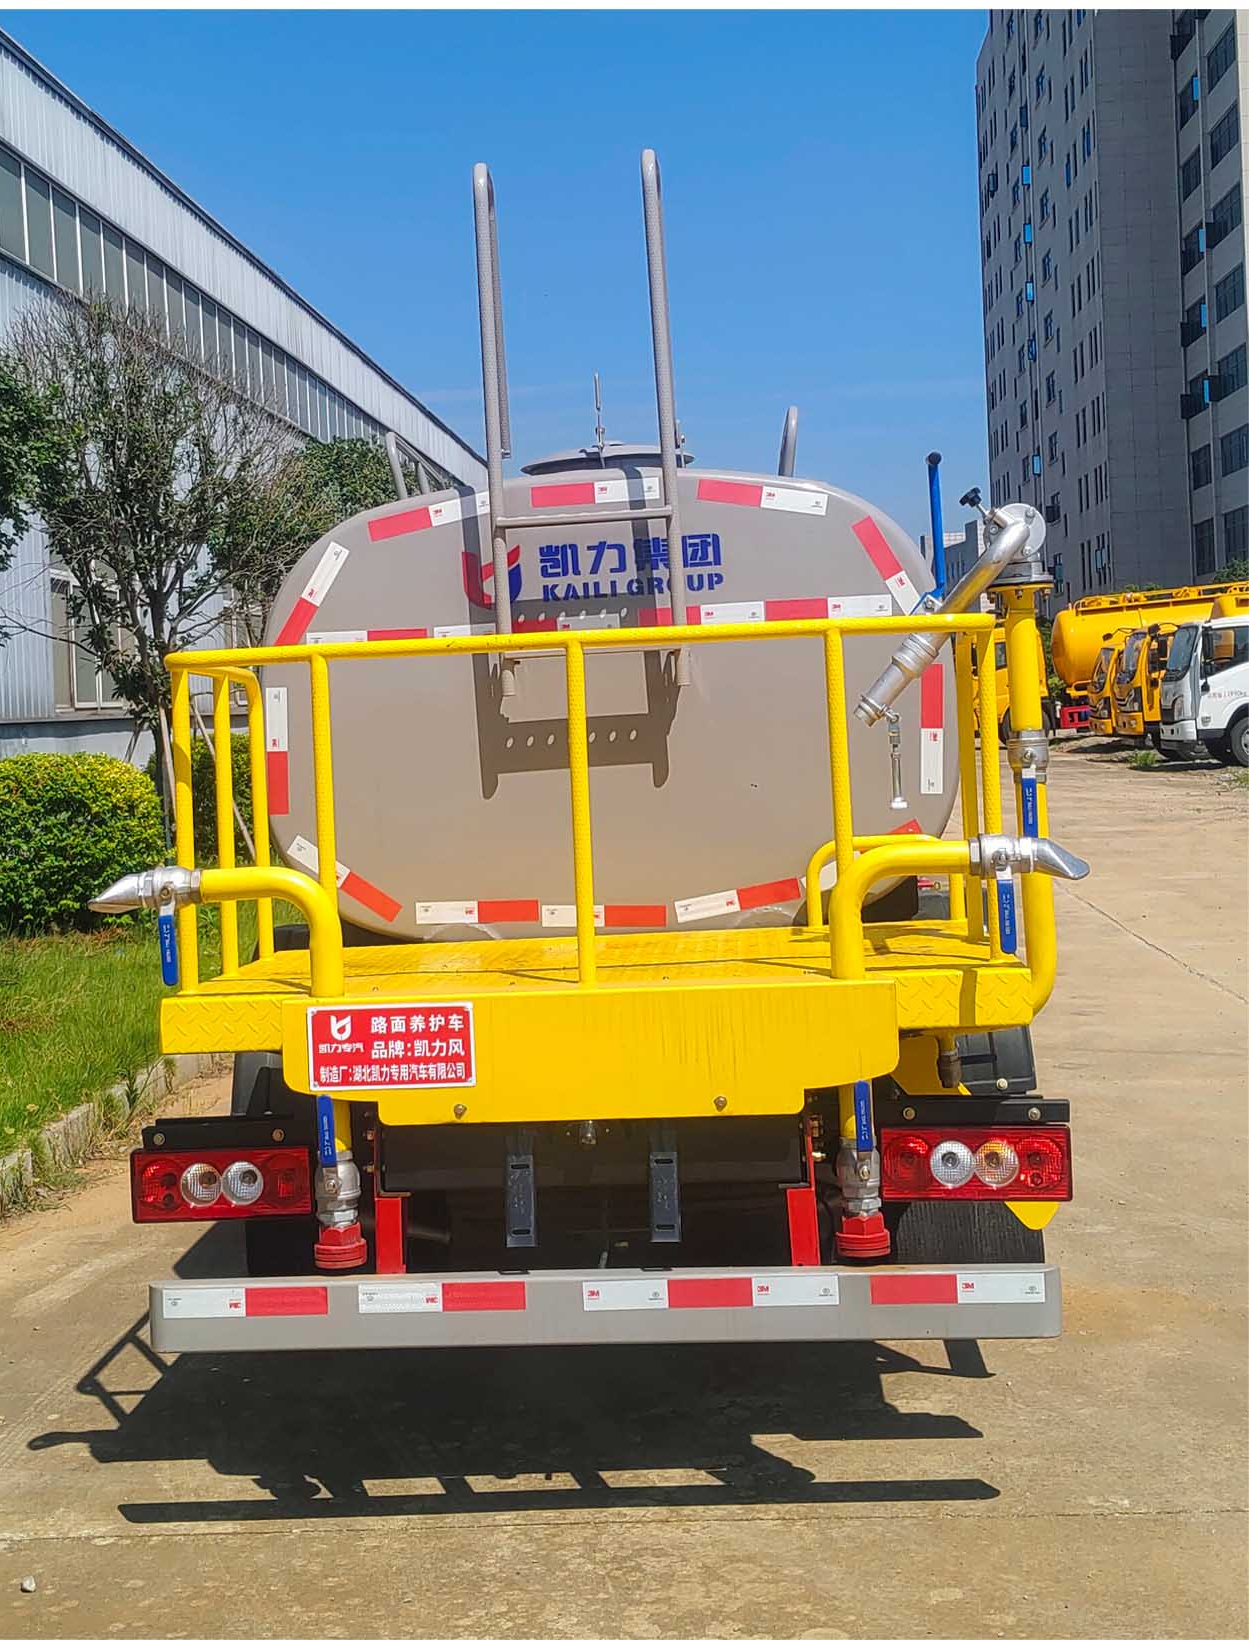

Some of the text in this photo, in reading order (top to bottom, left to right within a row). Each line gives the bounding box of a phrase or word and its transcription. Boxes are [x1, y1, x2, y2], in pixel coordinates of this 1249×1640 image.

[538, 533, 722, 579] 凯力集团
[543, 572, 724, 602] KAILI GRUP
[370, 1014, 465, 1034] 路面养护车
[757, 1285, 770, 1293] 3M
